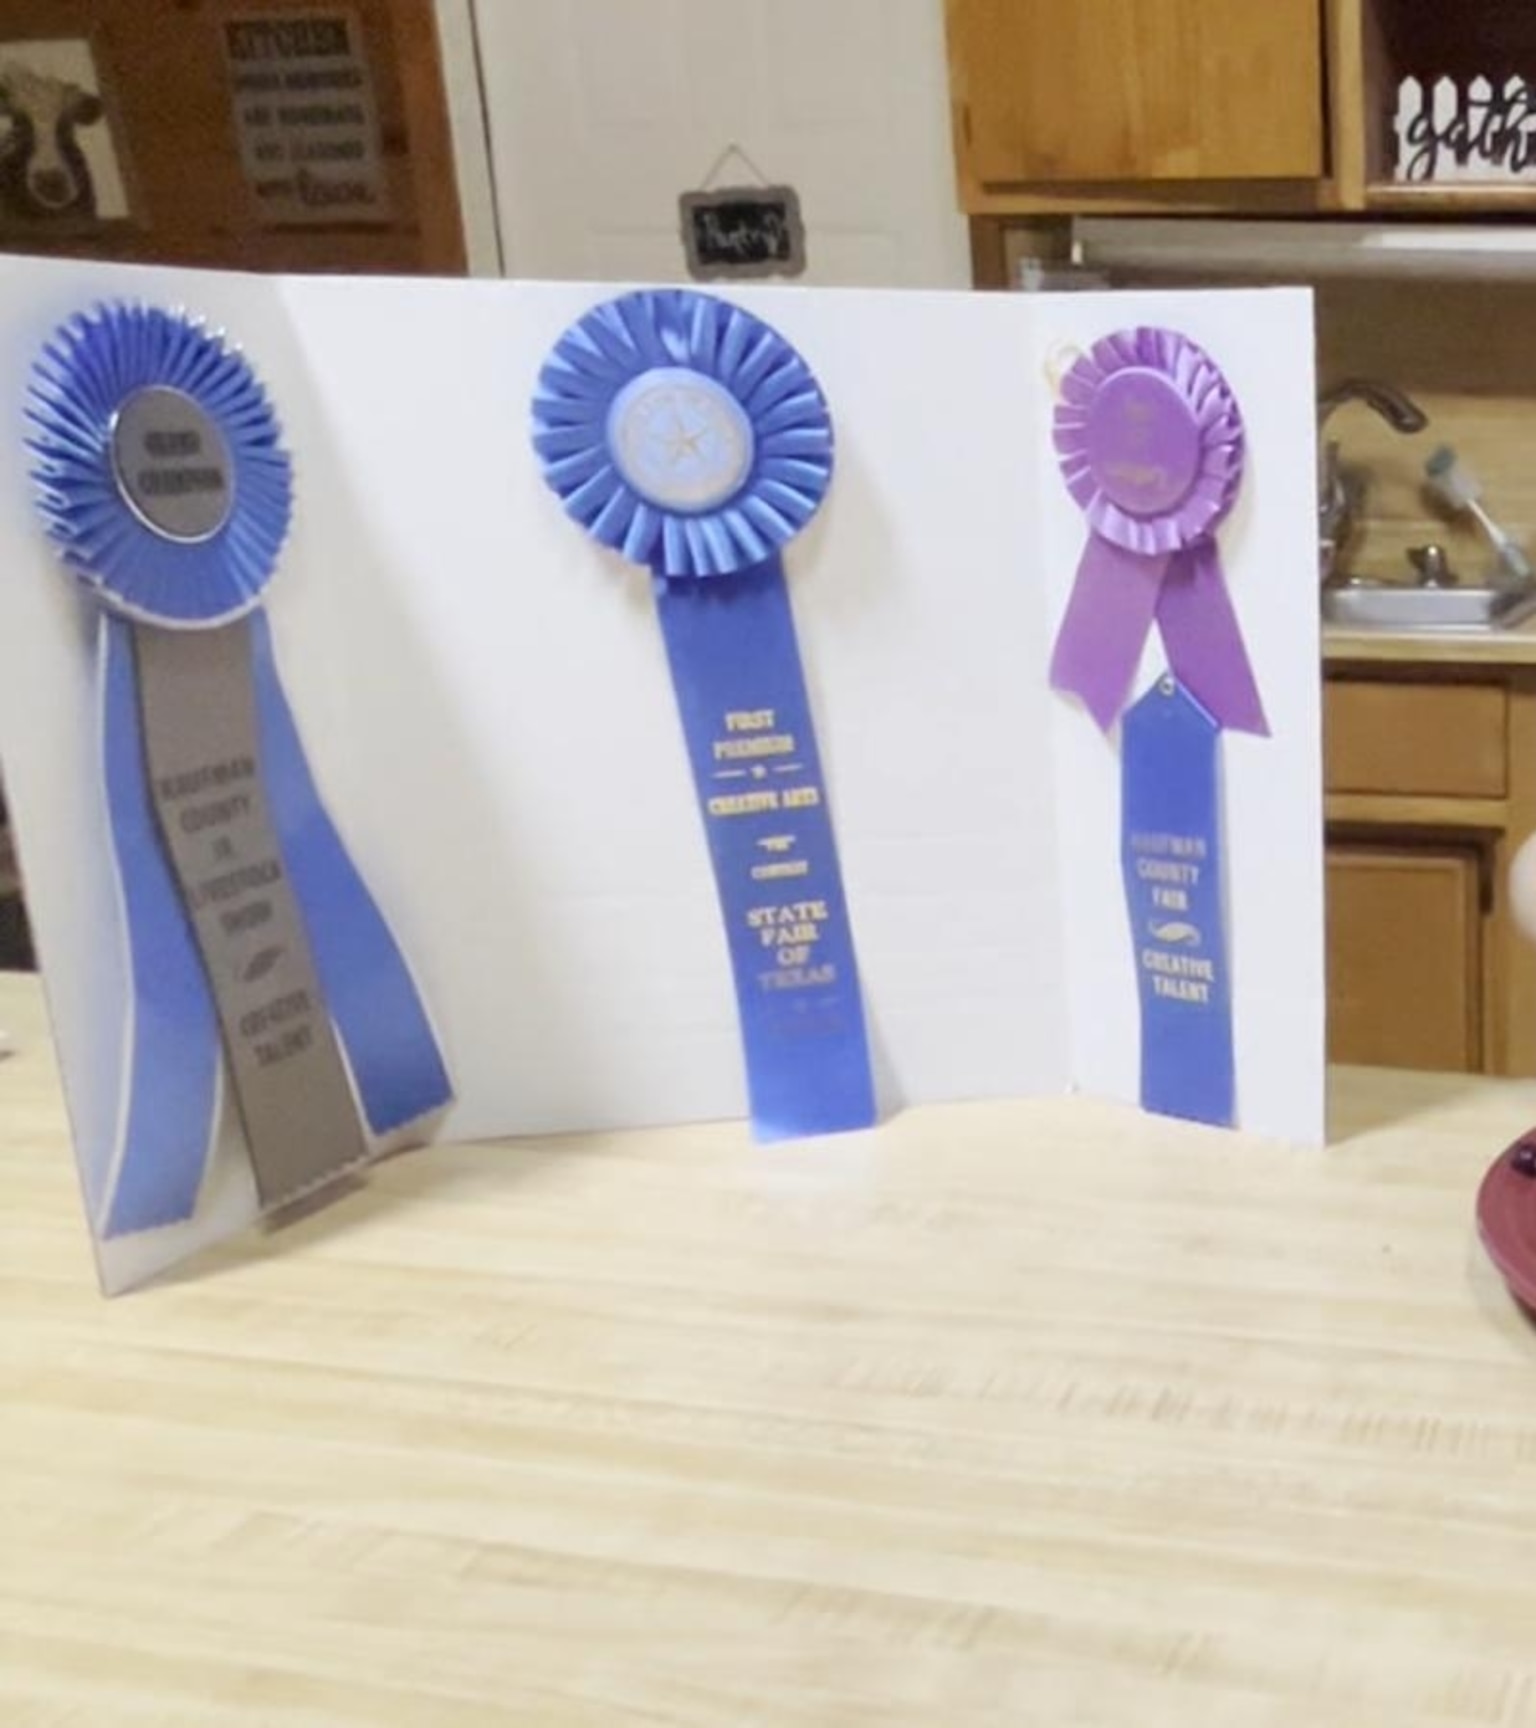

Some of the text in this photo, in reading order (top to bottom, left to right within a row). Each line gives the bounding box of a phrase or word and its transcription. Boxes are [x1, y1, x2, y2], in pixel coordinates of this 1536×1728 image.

[726, 709, 774, 731] FIRST
[714, 735, 794, 759] PREMIUM
[158, 757, 255, 799] KAUFMAN
[708, 785, 820, 816] CREATIVE ARTS
[179, 797, 250, 834] COUNTY
[1136, 857, 1200, 886] COUNTY
[1153, 887, 1187, 910] FAIR
[746, 899, 828, 928] STATE
[760, 922, 819, 948] FAIR
[776, 944, 811, 968] OF
[1143, 950, 1213, 982] CREATIVE
[757, 962, 836, 992] TEXAS
[1153, 975, 1208, 1003] TALENT
[240, 990, 310, 1037] CREATIVE
[253, 1023, 313, 1068] TALENT
